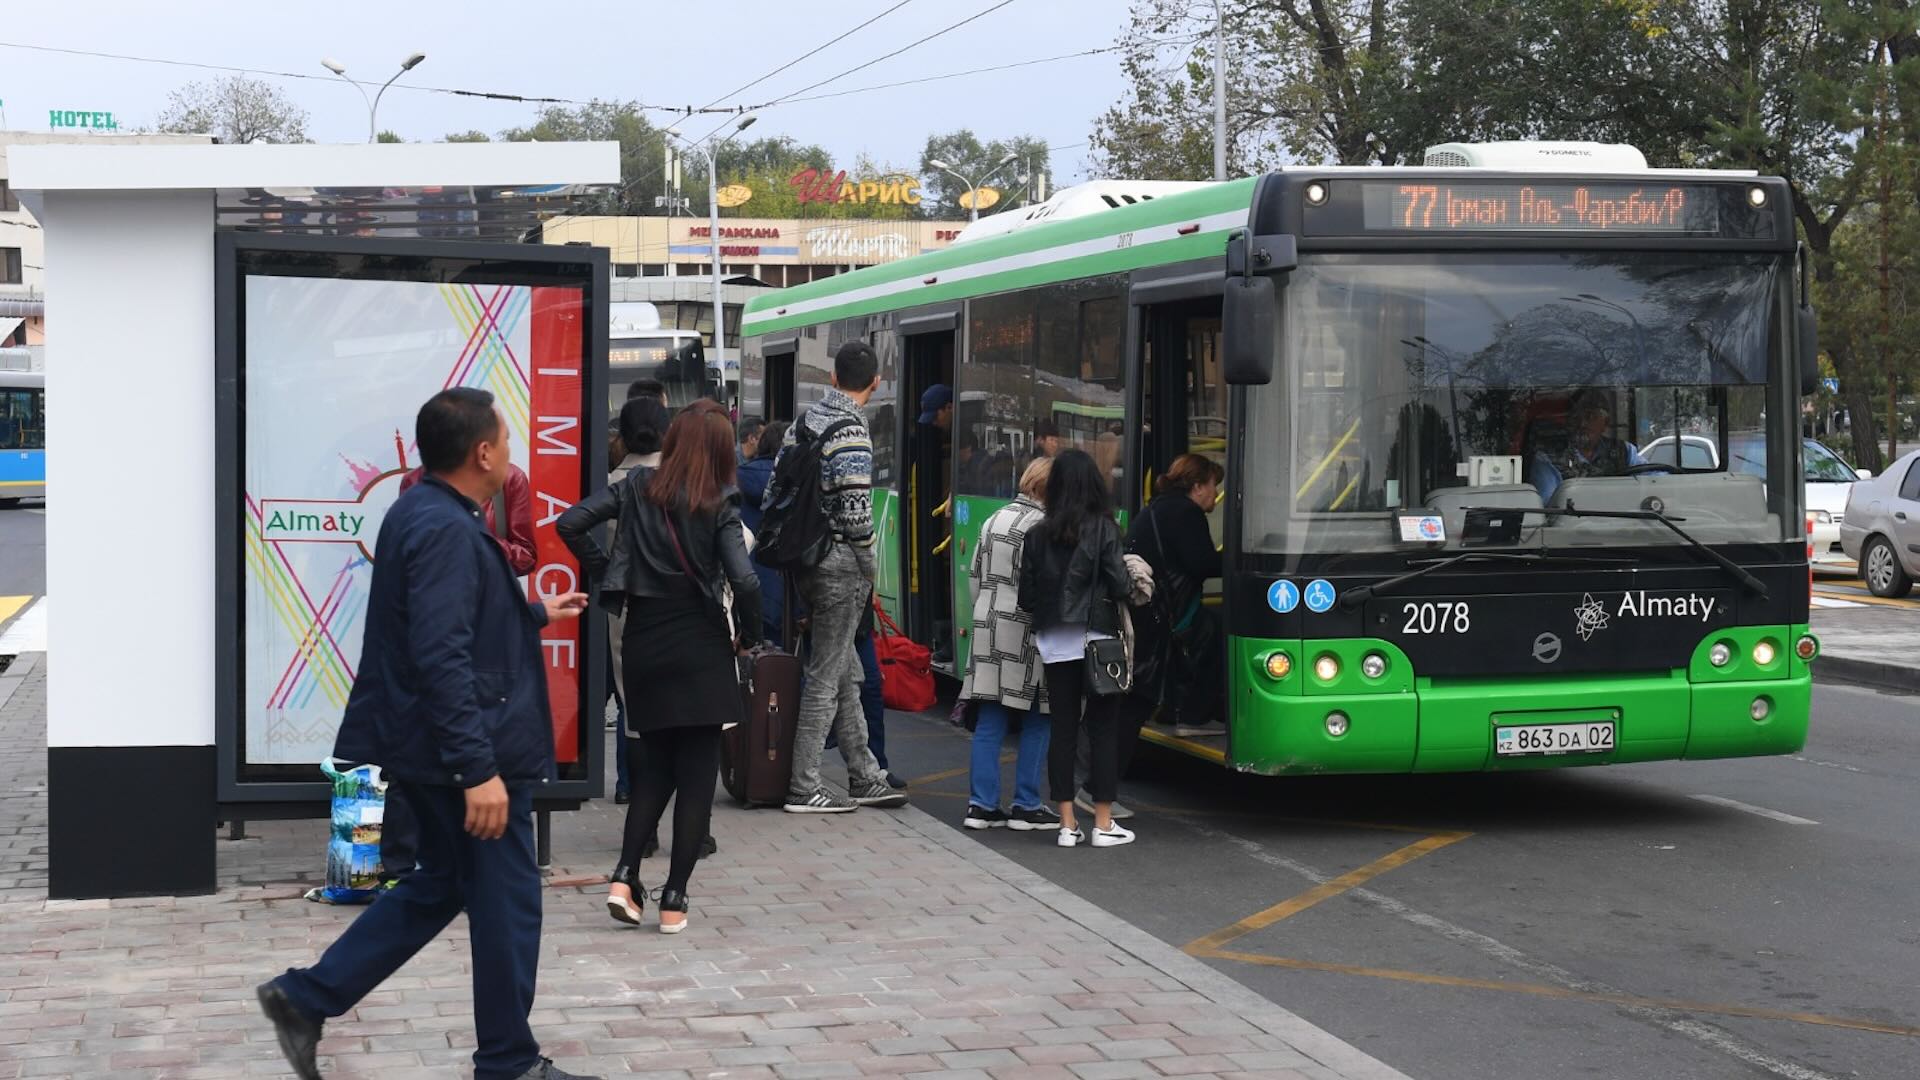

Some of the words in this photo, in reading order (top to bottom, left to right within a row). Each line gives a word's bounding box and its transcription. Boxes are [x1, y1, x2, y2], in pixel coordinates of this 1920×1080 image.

[49, 110, 117, 129] HOTEL
[1400, 186, 1437, 228] 77
[690, 227, 779, 239] МЕРАМХАНА
[267, 510, 364, 536] Almaty
[1402, 602, 1470, 634] 2078
[1617, 590, 1715, 622] Almaty
[1499, 741, 1513, 751] KZ
[1518, 729, 1553, 749] 863
[1559, 732, 1581, 748] DA
[1589, 726, 1612, 746] 02
